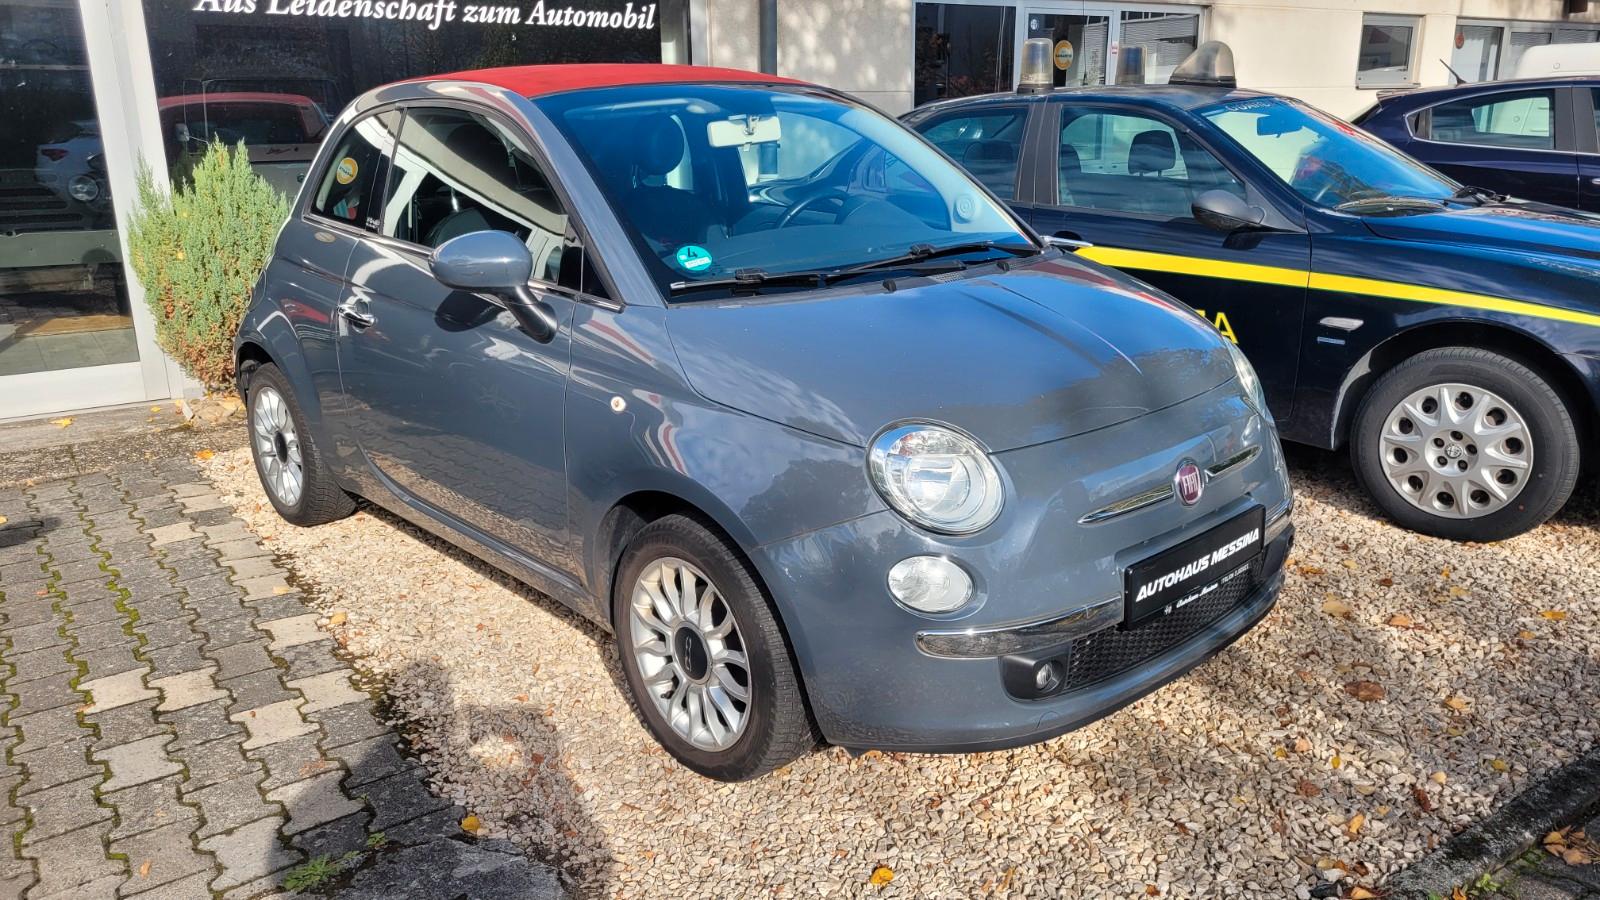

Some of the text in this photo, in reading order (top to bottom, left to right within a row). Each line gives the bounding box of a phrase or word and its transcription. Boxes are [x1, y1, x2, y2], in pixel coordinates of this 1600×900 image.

[462, 4, 521, 25] zum
[525, 0, 657, 29] Automobil
[1182, 472, 1198, 496] FIAT
[1135, 554, 1210, 603] AUTOHAUS
[1210, 527, 1260, 566] MESSINA
